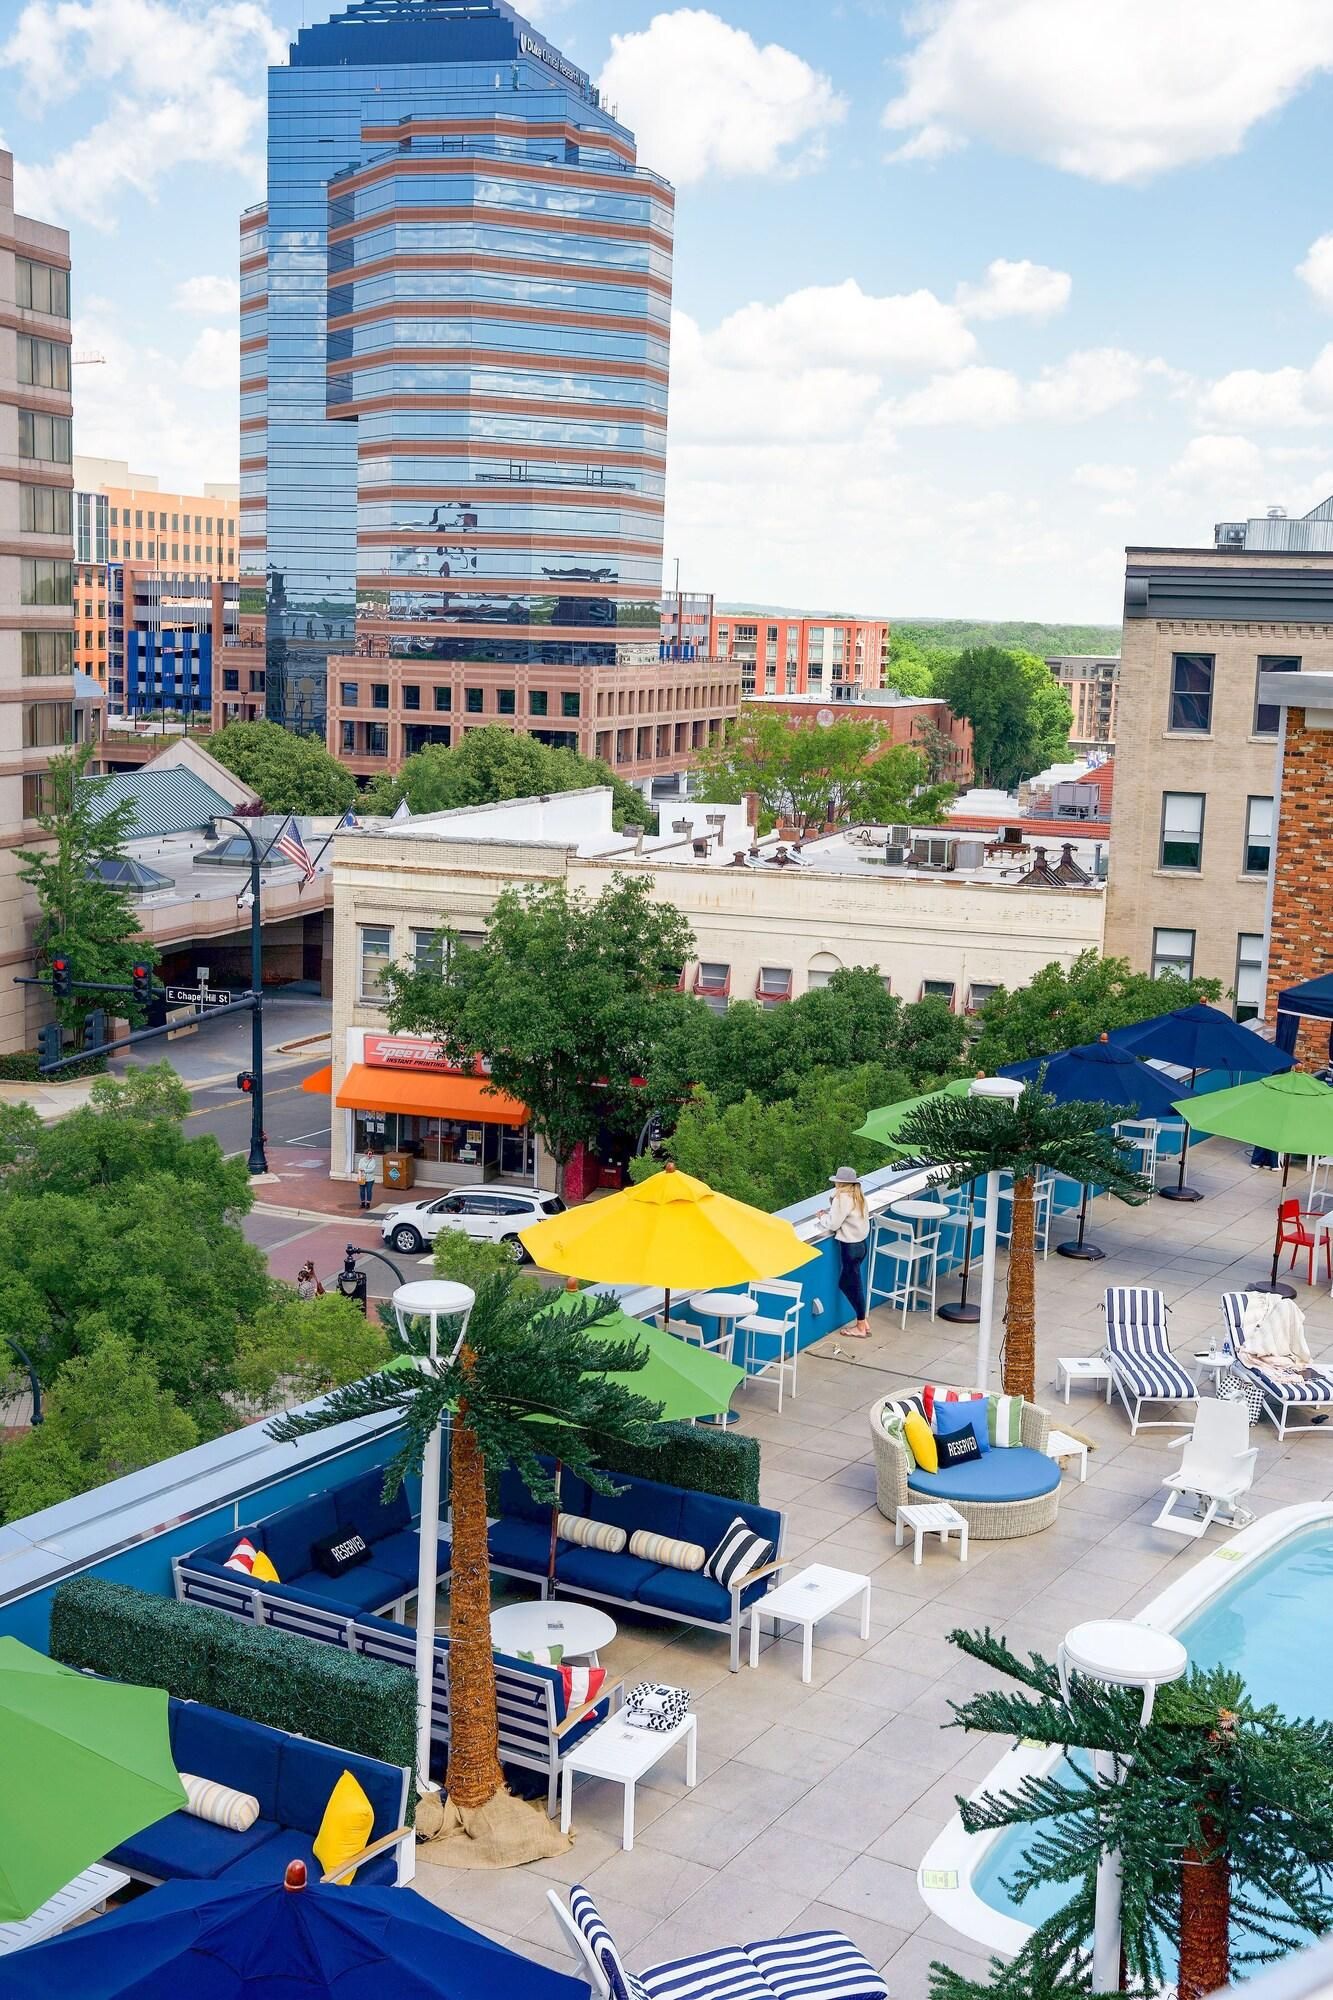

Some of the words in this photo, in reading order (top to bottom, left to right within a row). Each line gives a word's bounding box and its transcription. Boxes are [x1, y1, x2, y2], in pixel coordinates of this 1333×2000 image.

[527, 38, 542, 58] Duke
[542, 48, 560, 72] Clinical
[177, 991, 203, 1003] Chape
[218, 994, 228, 1003] St
[386, 1057, 414, 1066] INSTANT
[947, 1436, 977, 1457] RESERVED
[330, 1535, 366, 1562] RESERVED
